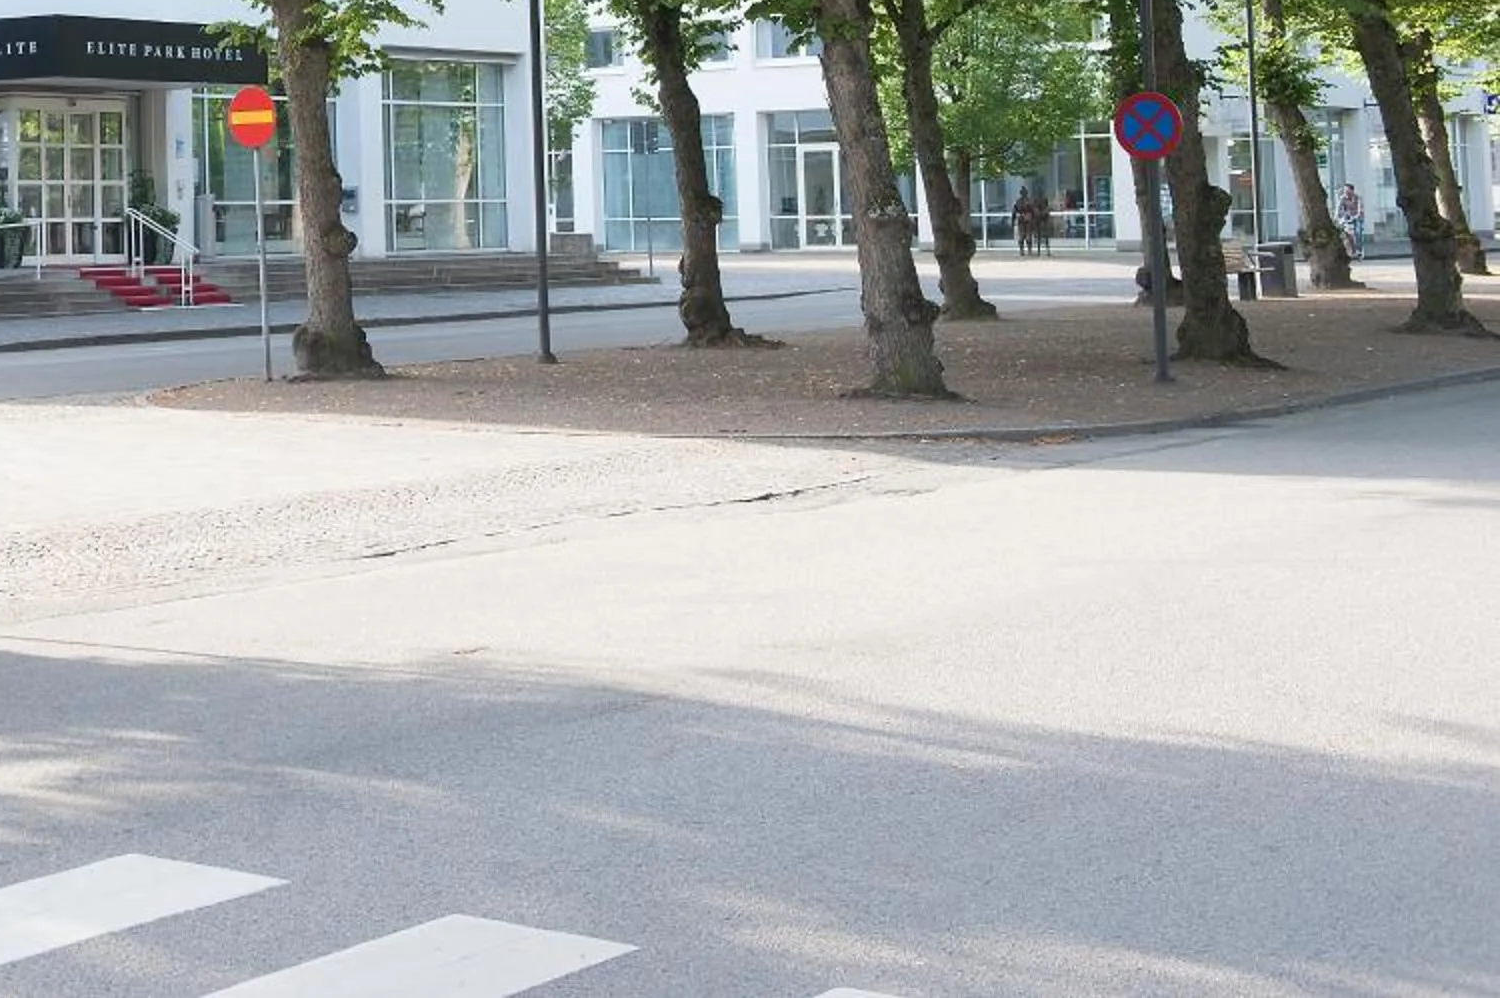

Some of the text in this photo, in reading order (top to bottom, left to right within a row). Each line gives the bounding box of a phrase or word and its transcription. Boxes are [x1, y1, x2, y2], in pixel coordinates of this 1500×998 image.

[87, 41, 243, 62] ELITE PARK HOTEL
